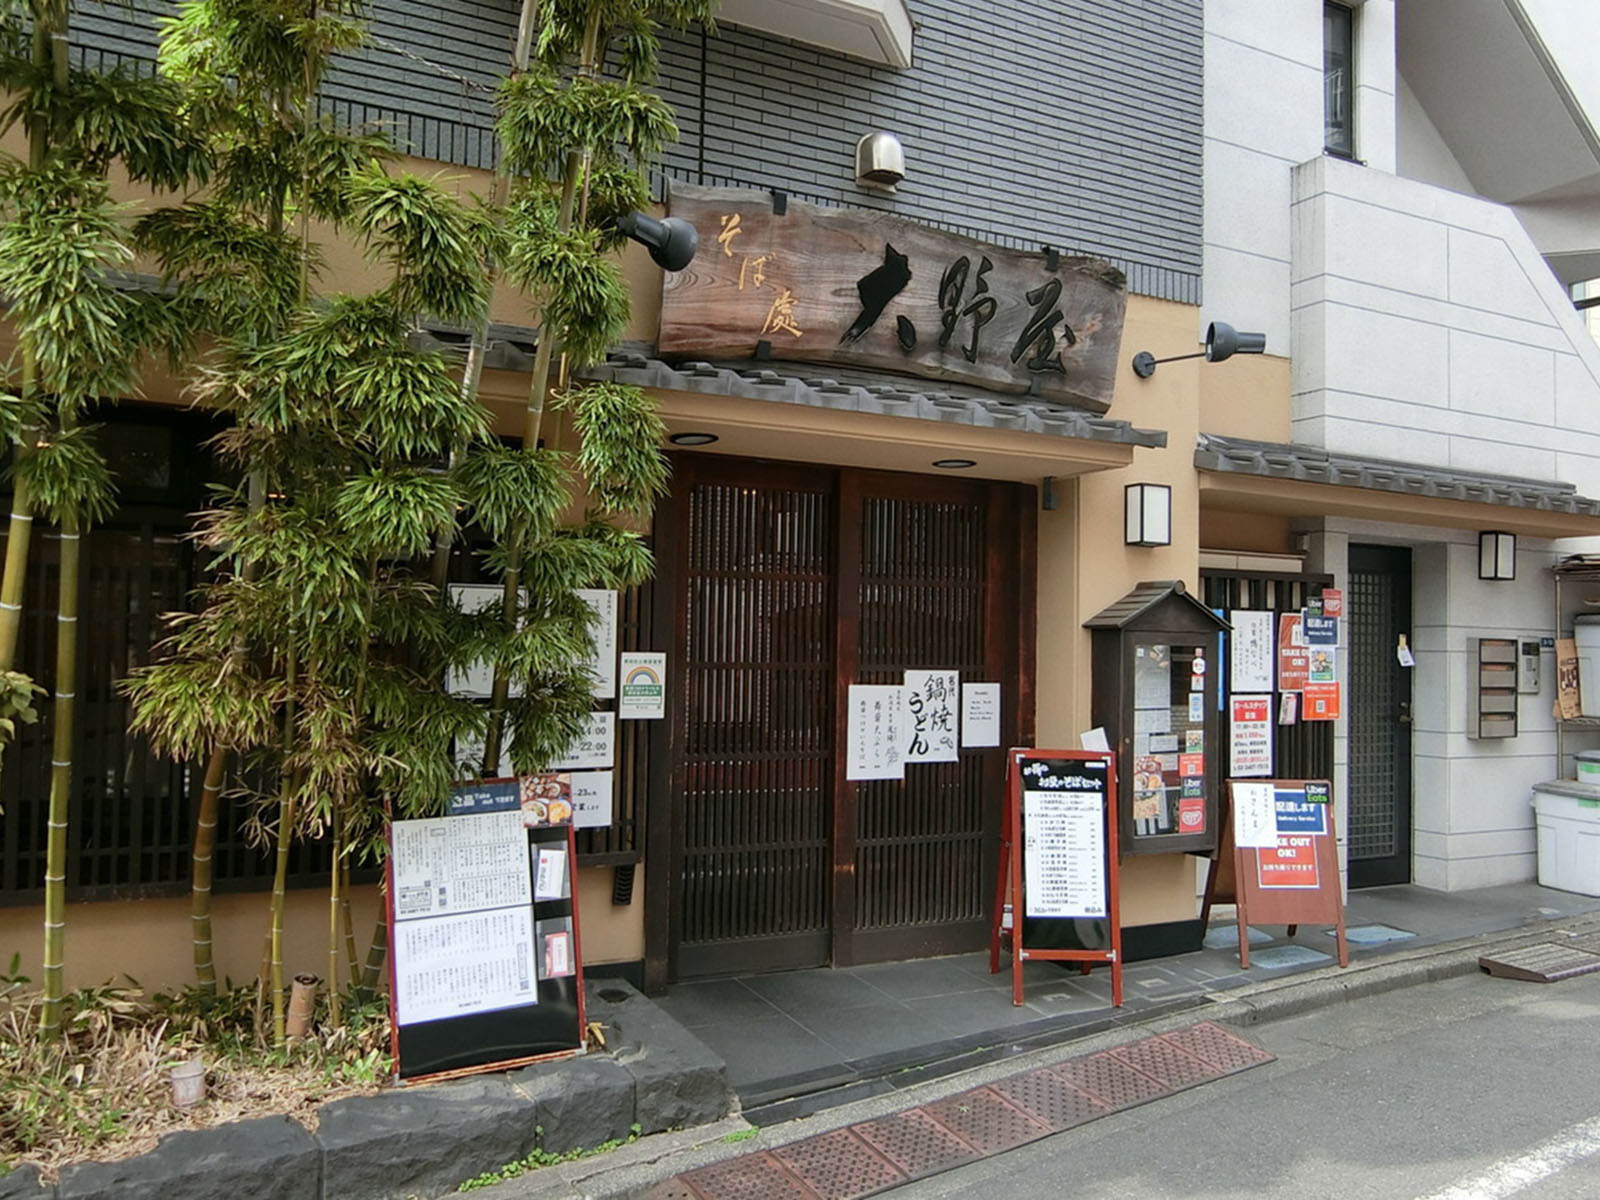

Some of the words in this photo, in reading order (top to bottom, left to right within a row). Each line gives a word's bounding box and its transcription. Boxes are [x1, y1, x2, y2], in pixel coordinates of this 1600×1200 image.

[908, 691, 930, 756] うどん
[1184, 779, 1201, 787] Uber
[1306, 785, 1327, 794] Uber
[1307, 793, 1328, 802] Eats
[1290, 838, 1311, 846] OUT
